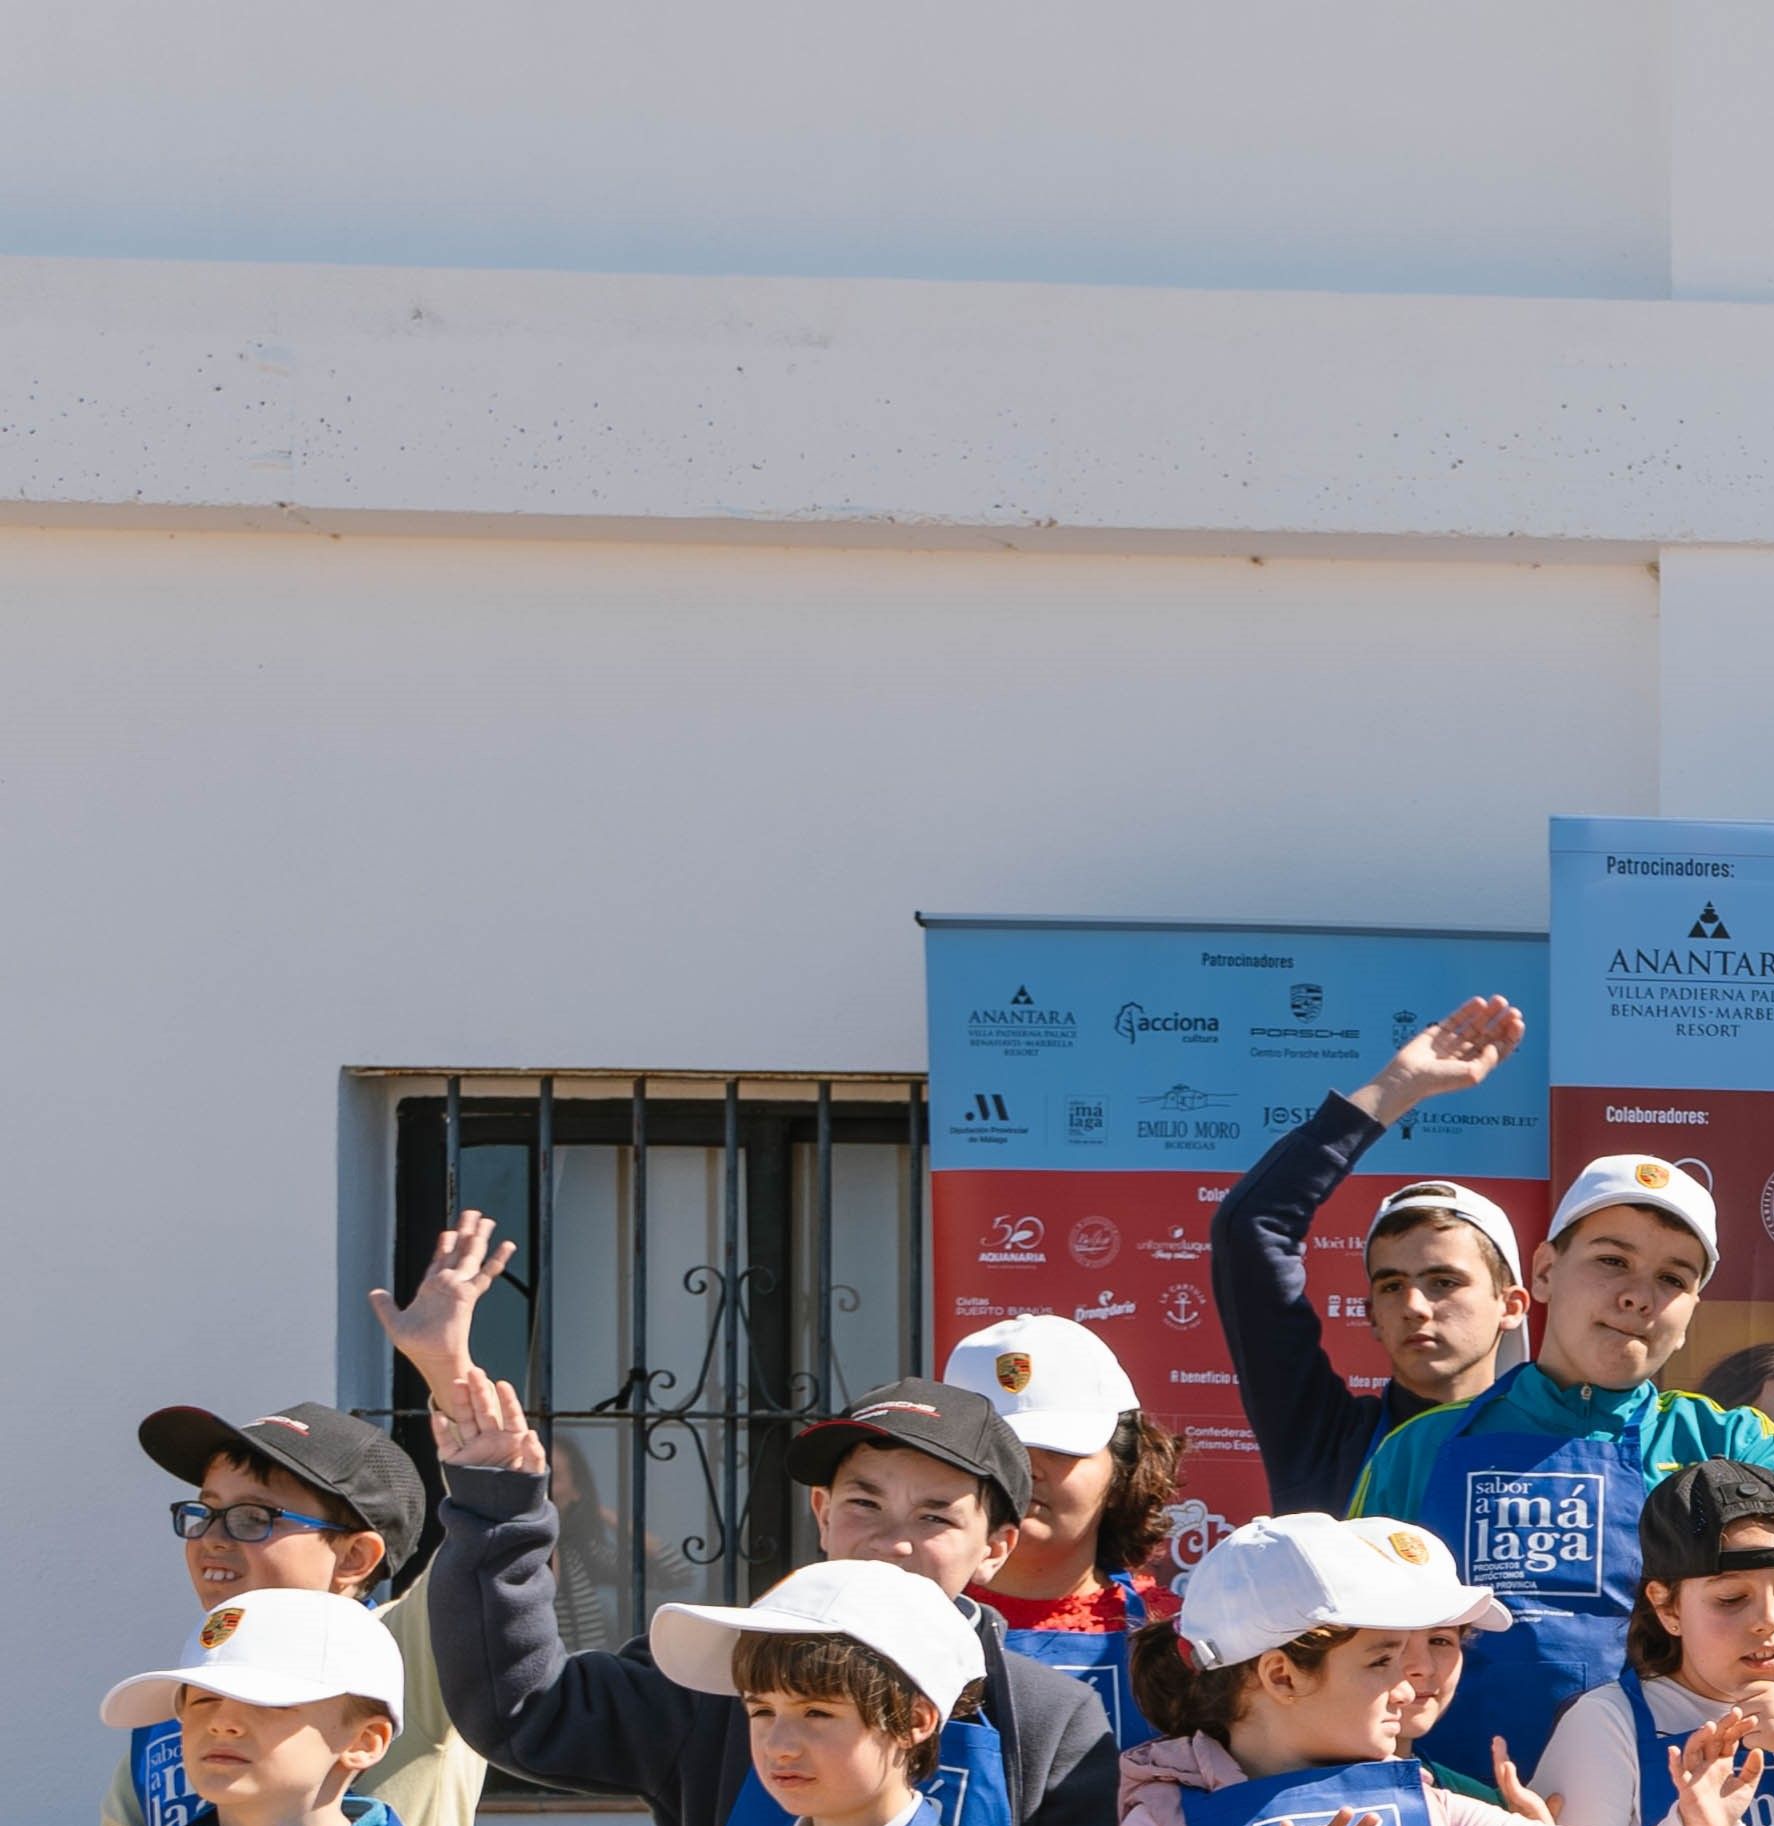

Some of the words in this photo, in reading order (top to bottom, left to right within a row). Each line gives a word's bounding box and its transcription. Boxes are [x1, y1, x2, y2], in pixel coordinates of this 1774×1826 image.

[1606, 855, 1735, 880] Patrocinadores:
[1202, 952, 1294, 969] Patrocinadores
[1608, 986, 1654, 999] VILLA
[1660, 987, 1746, 1002] PADIERNA
[968, 1010, 1076, 1025] ANANTARA
[1138, 1013, 1219, 1032] acciona
[1182, 1034, 1218, 1043] cultura
[1250, 1028, 1360, 1039] PORSCHE
[1676, 1024, 1740, 1037] RESORT
[1250, 1048, 1281, 1058] Centro
[1284, 1048, 1320, 1058] Porsche
[1323, 1049, 1360, 1059] Marbella
[1423, 1113, 1438, 1124] LE
[1440, 1112, 1499, 1126] CORDON
[1503, 1115, 1535, 1128] BLEU
[1606, 1106, 1709, 1126] Colaboradores:
[1138, 1121, 1188, 1138] EMILIO
[1194, 1122, 1240, 1139] MORO
[979, 1252, 1046, 1262] AQUANARIA
[956, 1307, 1005, 1316] PUERTO
[1475, 1477, 1533, 1495] sabor
[1475, 1497, 1491, 1514] a
[1494, 1484, 1594, 1529] má
[1474, 1519, 1593, 1572] laga
